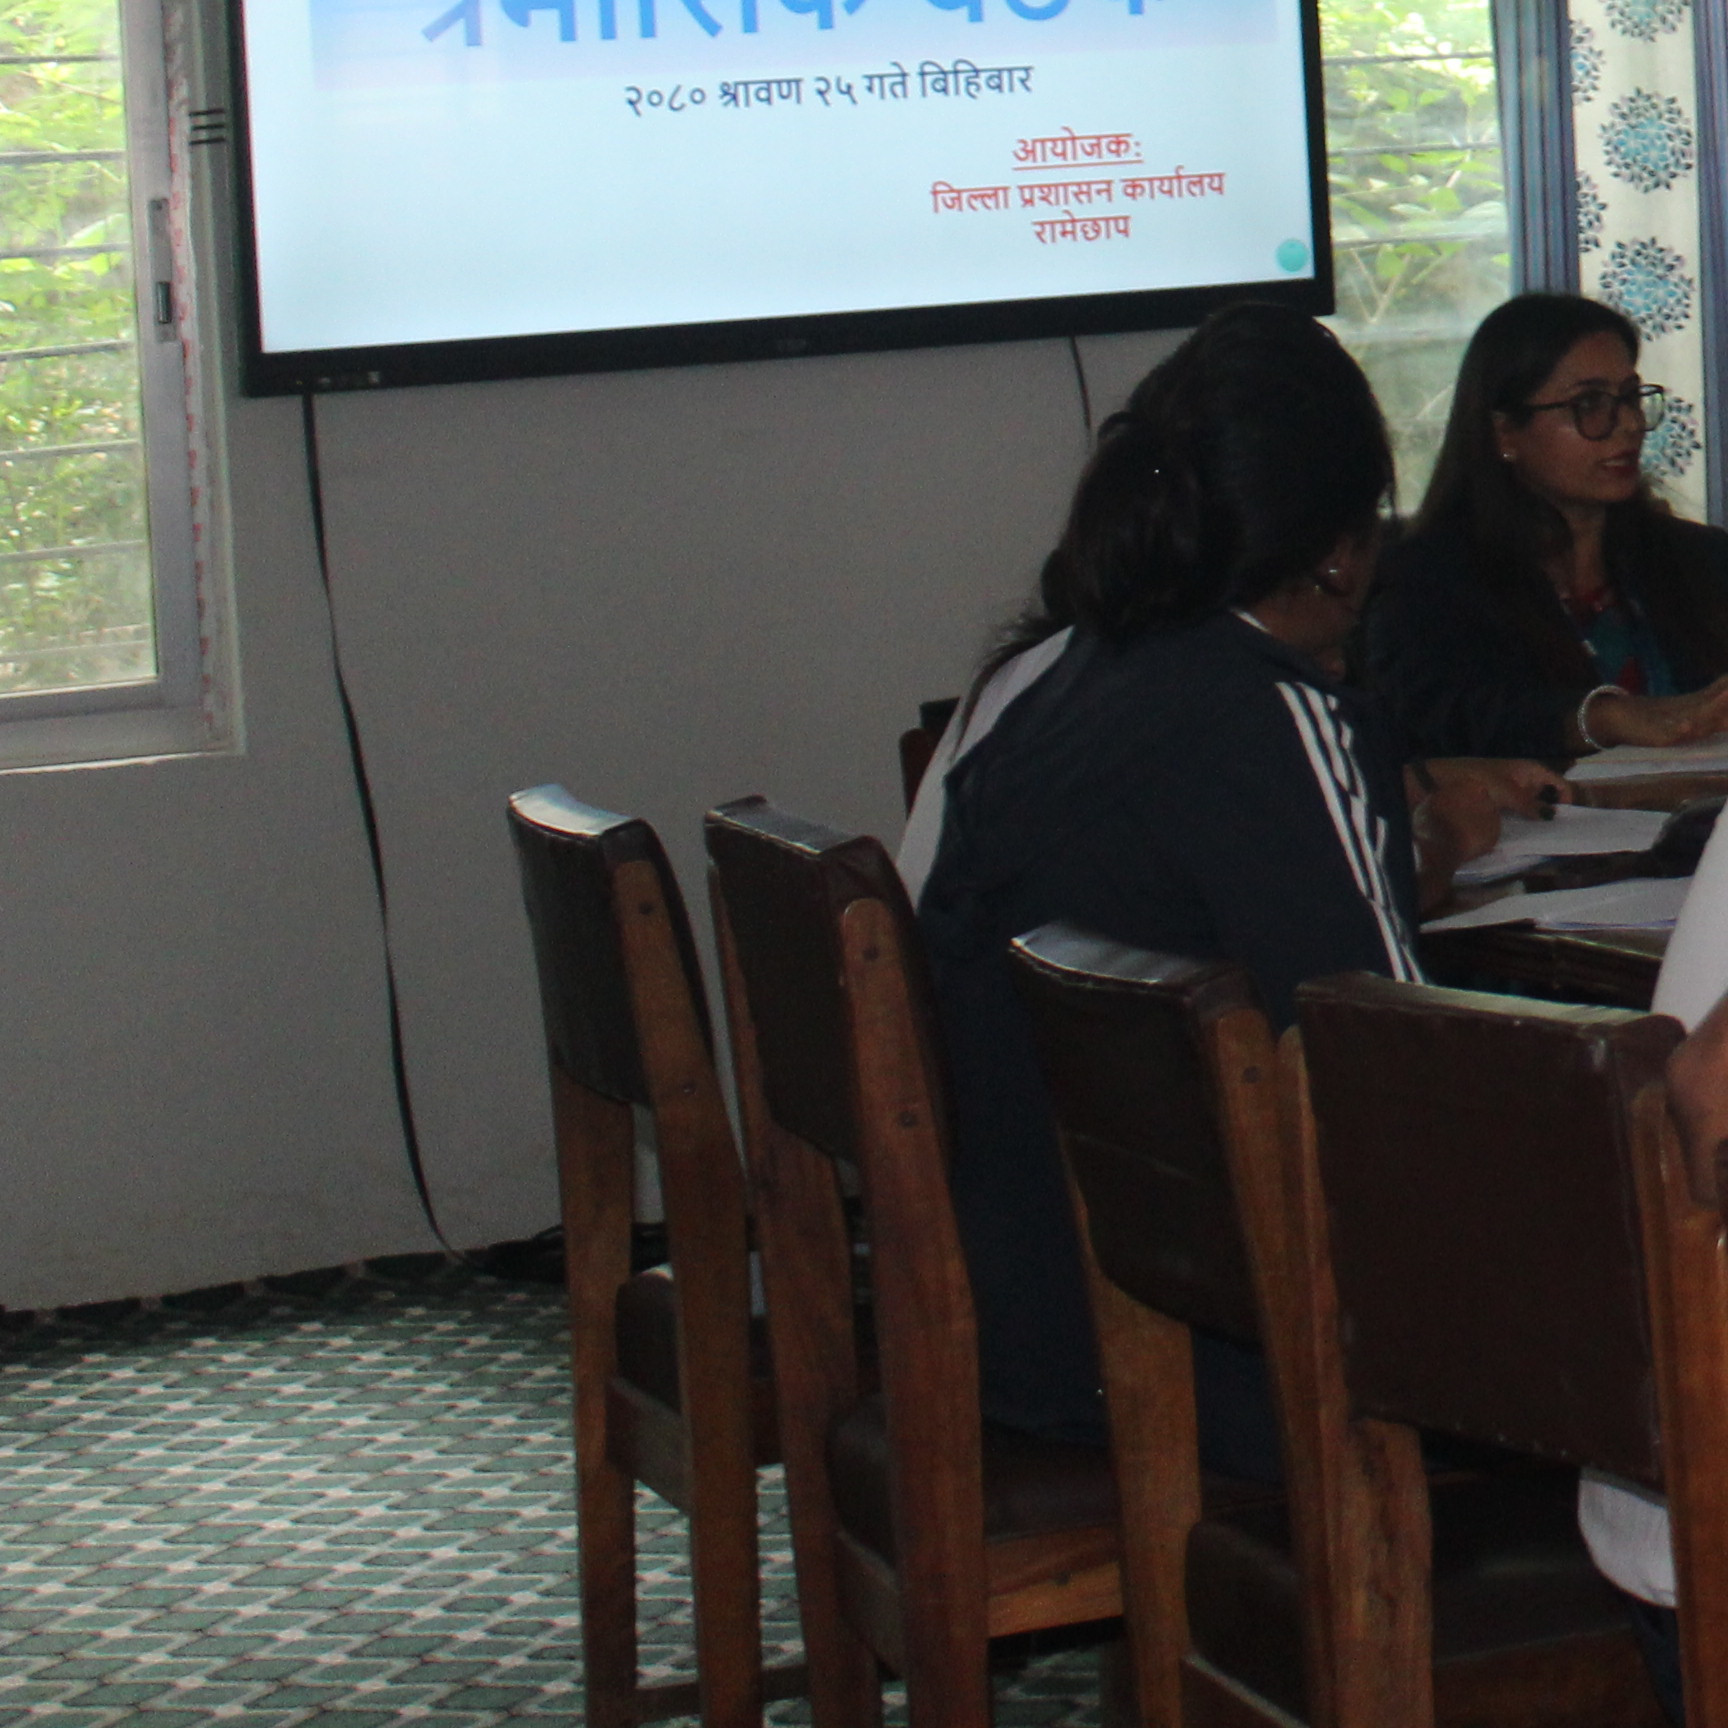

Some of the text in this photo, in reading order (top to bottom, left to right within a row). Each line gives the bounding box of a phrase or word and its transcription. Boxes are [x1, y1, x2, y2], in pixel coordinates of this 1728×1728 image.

[623, 57, 1035, 116] २०८० श्रावण २५ गते बिहिबार
[930, 165, 1226, 214] जिल्ला प्रशासन कार्यालय
[1031, 210, 1132, 245] रामेछाप
